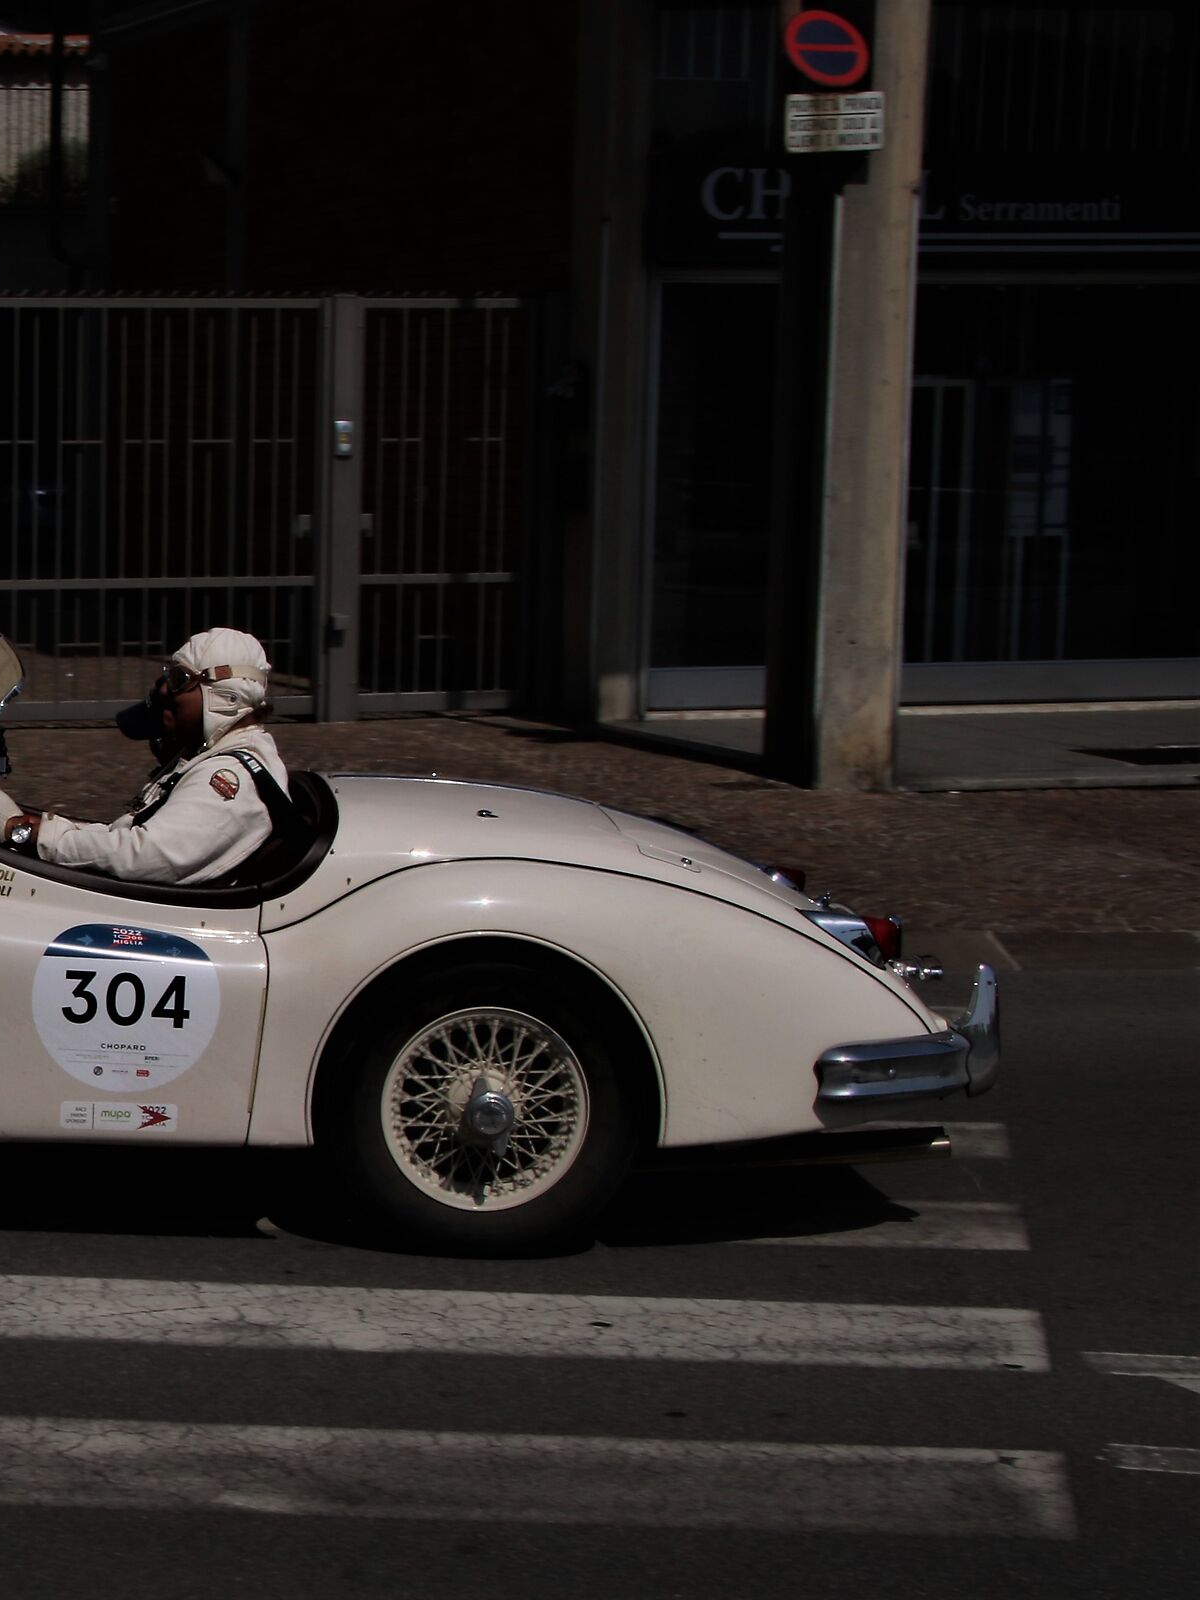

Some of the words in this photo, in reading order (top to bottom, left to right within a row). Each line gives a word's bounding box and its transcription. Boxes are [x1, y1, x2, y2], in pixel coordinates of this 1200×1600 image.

[958, 193, 1121, 222] Serramenti
[112, 927, 142, 936] 2022
[61, 970, 190, 1029] 304
[100, 1043, 146, 1051] CHOPARD
